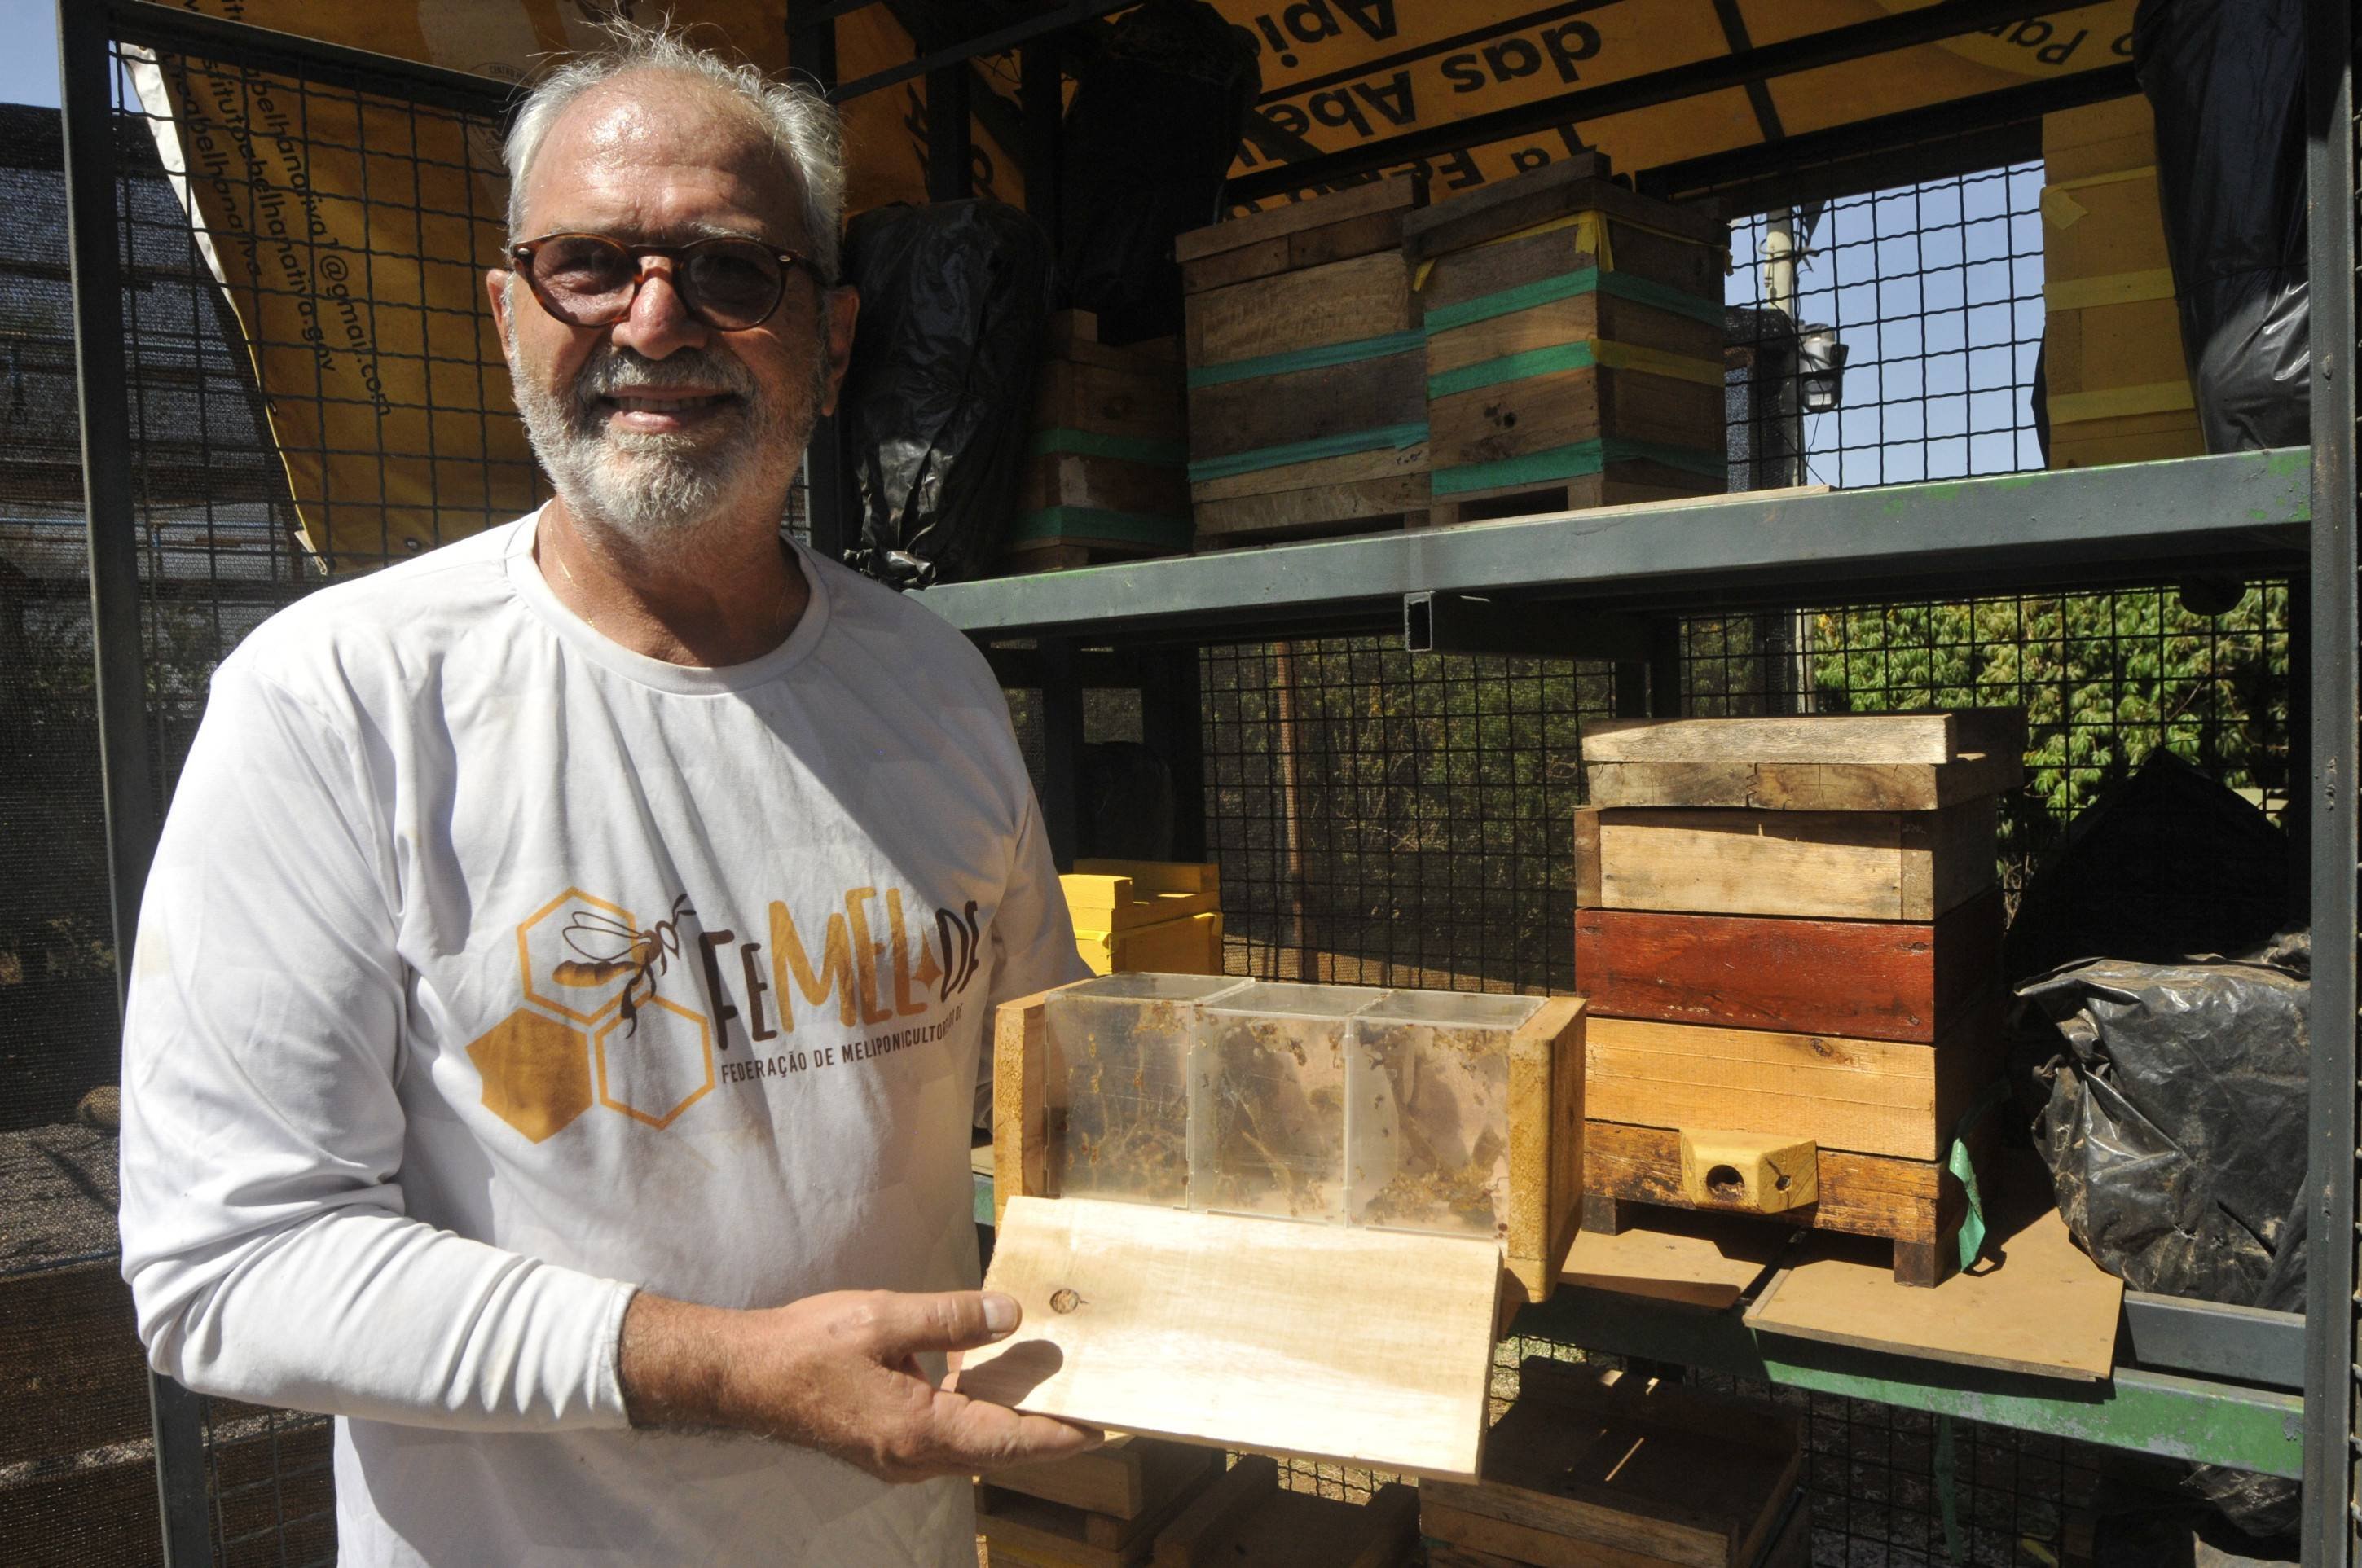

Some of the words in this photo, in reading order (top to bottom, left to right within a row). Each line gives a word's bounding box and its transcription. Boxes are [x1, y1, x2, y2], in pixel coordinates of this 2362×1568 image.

[1439, 20, 1603, 94] das
[721, 1049, 807, 1083] FEDERAÇÃO
[814, 1048, 834, 1068] DE
